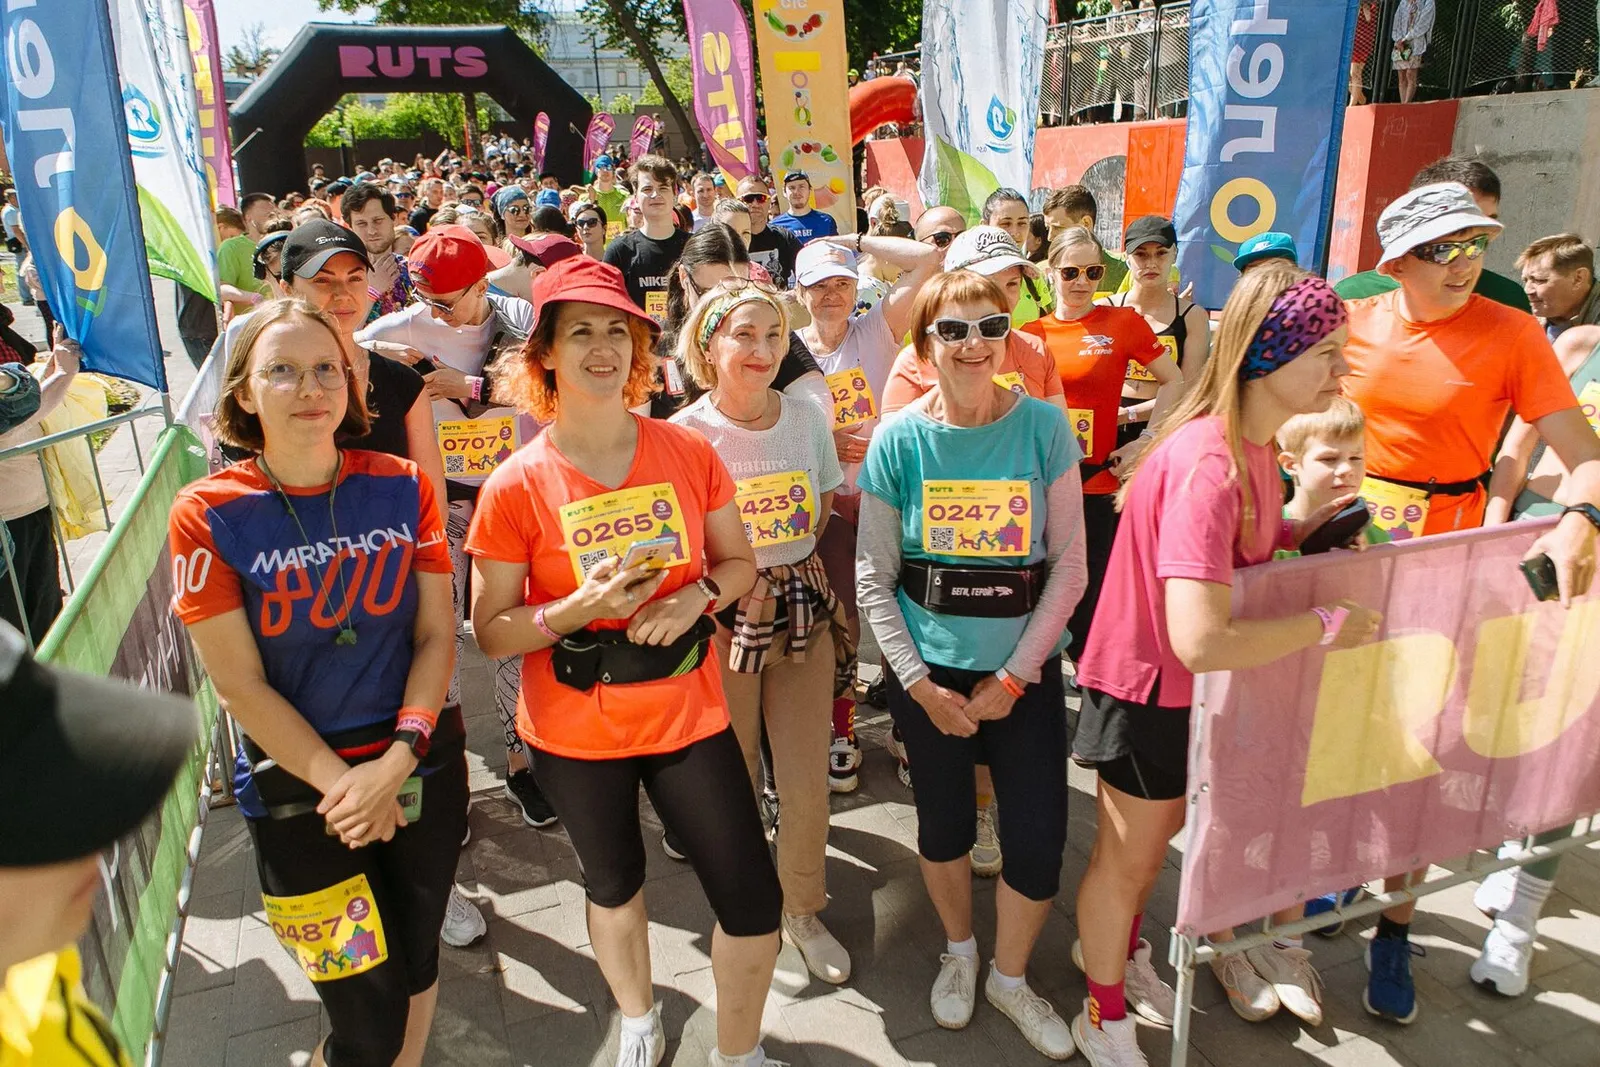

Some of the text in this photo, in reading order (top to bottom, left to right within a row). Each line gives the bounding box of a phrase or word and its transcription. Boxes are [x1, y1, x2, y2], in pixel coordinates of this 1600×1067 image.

[338, 45, 489, 78] RUTS
[639, 276, 668, 287] NIKE
[443, 435, 498, 451] 0707
[656, 501, 668, 512] 3
[742, 494, 790, 515] 423
[928, 504, 1001, 521] 0247
[572, 512, 654, 547] 0265
[250, 522, 414, 574] MARATHON
[352, 900, 364, 911] 3
[271, 914, 343, 942] 0487
